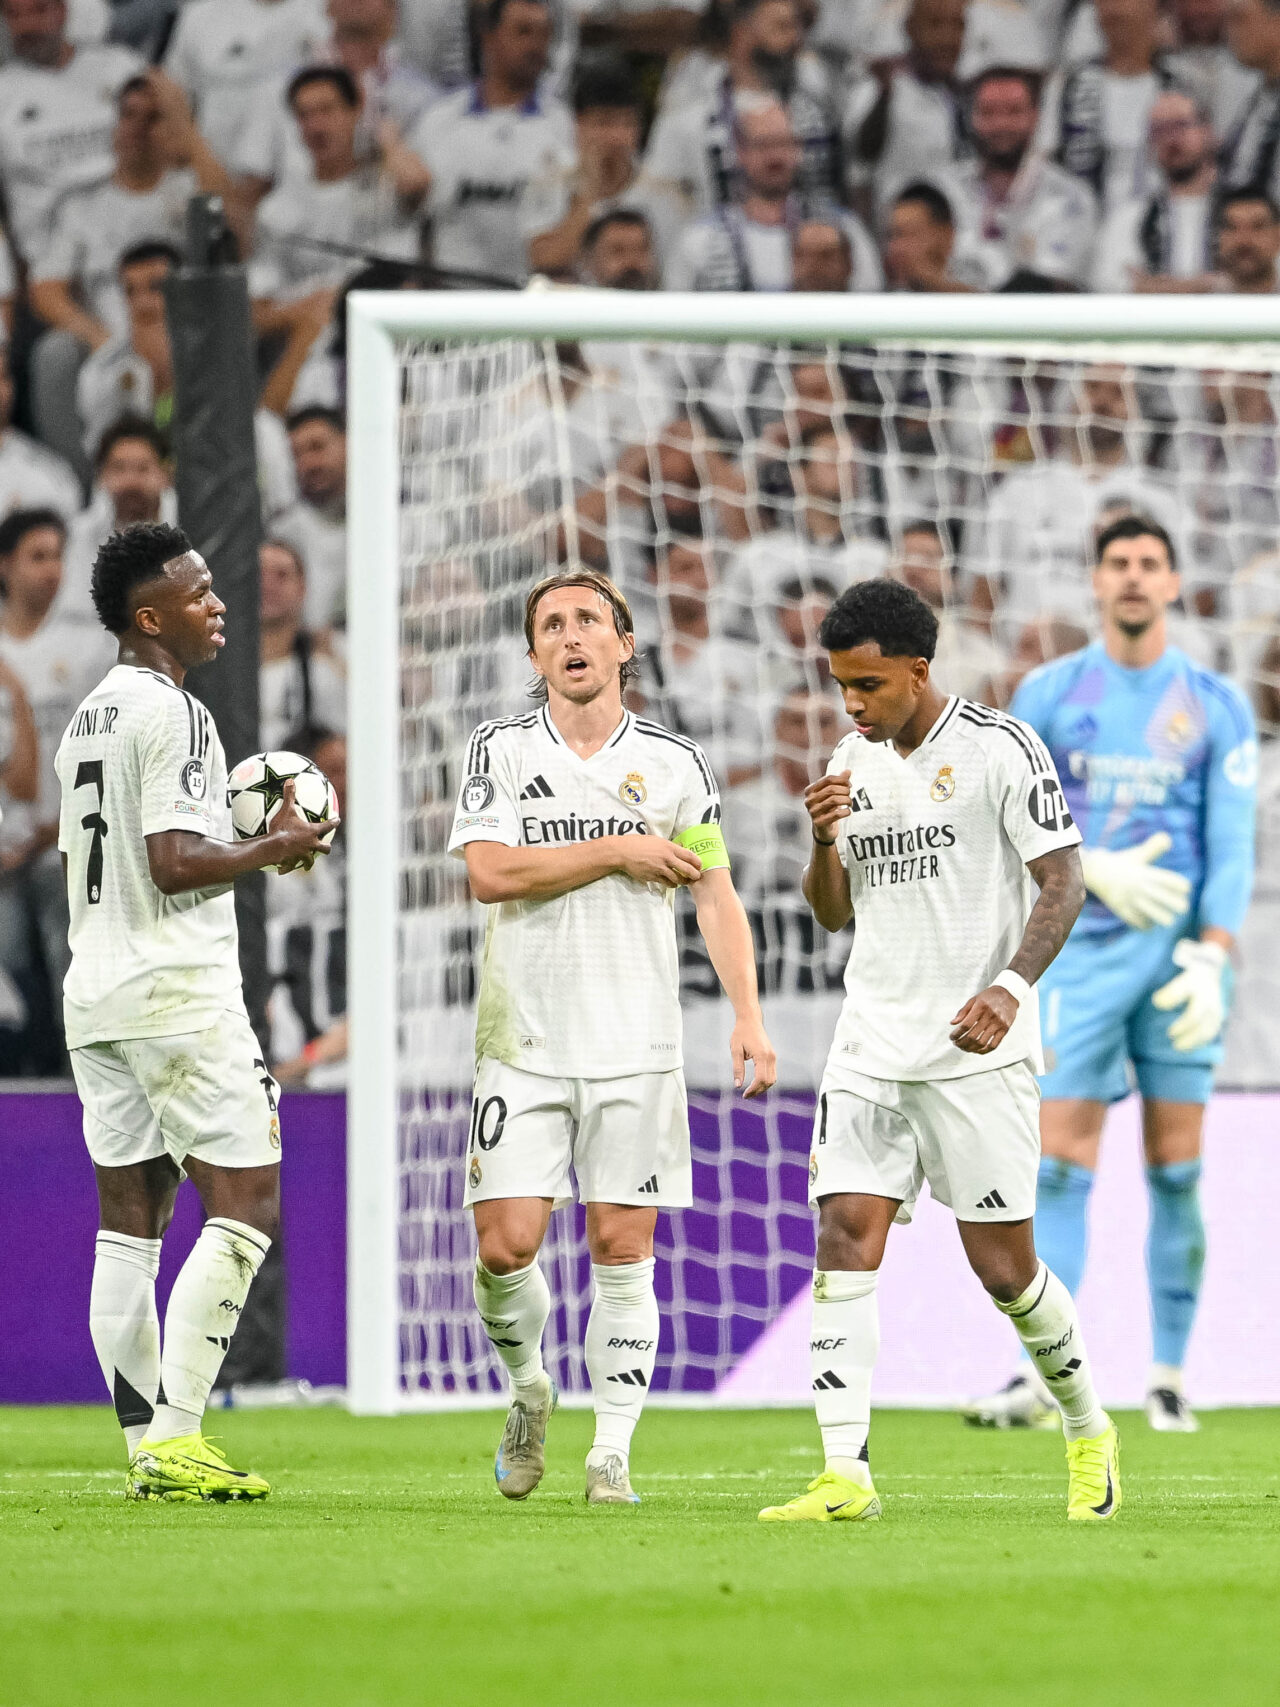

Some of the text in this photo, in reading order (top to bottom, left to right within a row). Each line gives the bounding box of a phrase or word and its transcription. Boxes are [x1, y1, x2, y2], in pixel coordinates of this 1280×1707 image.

[69, 706, 119, 738] VINI JR.
[470, 791, 481, 801] 15
[1038, 779, 1072, 832] hp
[73, 760, 108, 905] 7
[522, 812, 647, 845] Emirates
[847, 824, 956, 861] Emirates
[865, 864, 885, 888] FLY
[469, 1095, 508, 1154] 10
[607, 1337, 654, 1352] RMCF
[1035, 1323, 1074, 1357] RMCF
